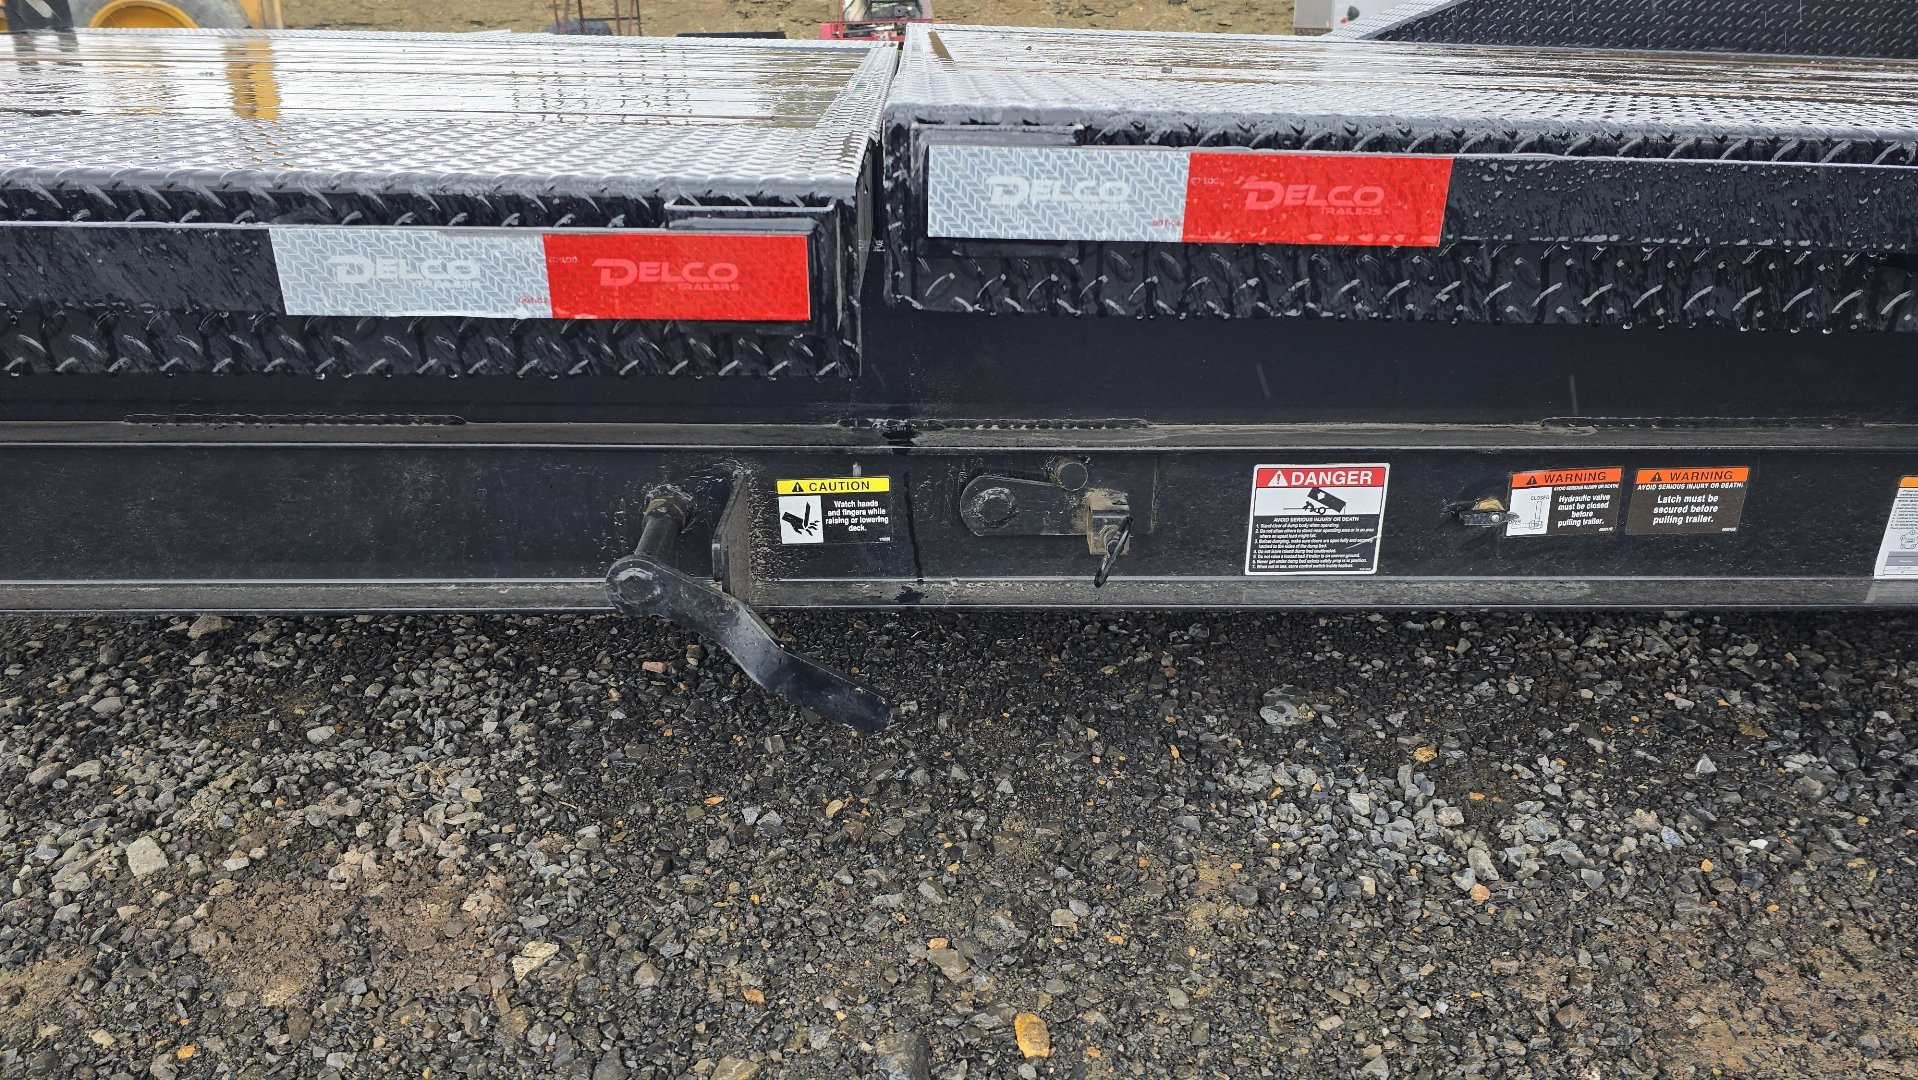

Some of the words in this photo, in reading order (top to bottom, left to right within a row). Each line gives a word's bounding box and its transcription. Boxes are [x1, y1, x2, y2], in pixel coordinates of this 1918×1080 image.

[986, 176, 1129, 205] DELCO
[1241, 181, 1384, 210] DELCO
[1321, 207, 1382, 215] TRAILERS
[327, 255, 480, 283] DELCO
[592, 258, 739, 286] DELCO
[677, 283, 739, 291] TRAILERS
[1291, 471, 1372, 485] DANGER
[1545, 472, 1606, 483] WARNING
[1670, 471, 1733, 481] WARNING
[809, 481, 869, 491] CAUTION
[1559, 495, 1590, 503] Hydraulic
[1657, 495, 1681, 503] Latch
[1708, 494, 1718, 502] be
[1587, 501, 1609, 509] closed
[1653, 505, 1688, 513] secured
[1690, 505, 1718, 513] before
[826, 518, 849, 526] raising
[1558, 519, 1581, 528] pulling
[1653, 515, 1683, 525] pulling
[1685, 515, 1713, 523] trailer.
